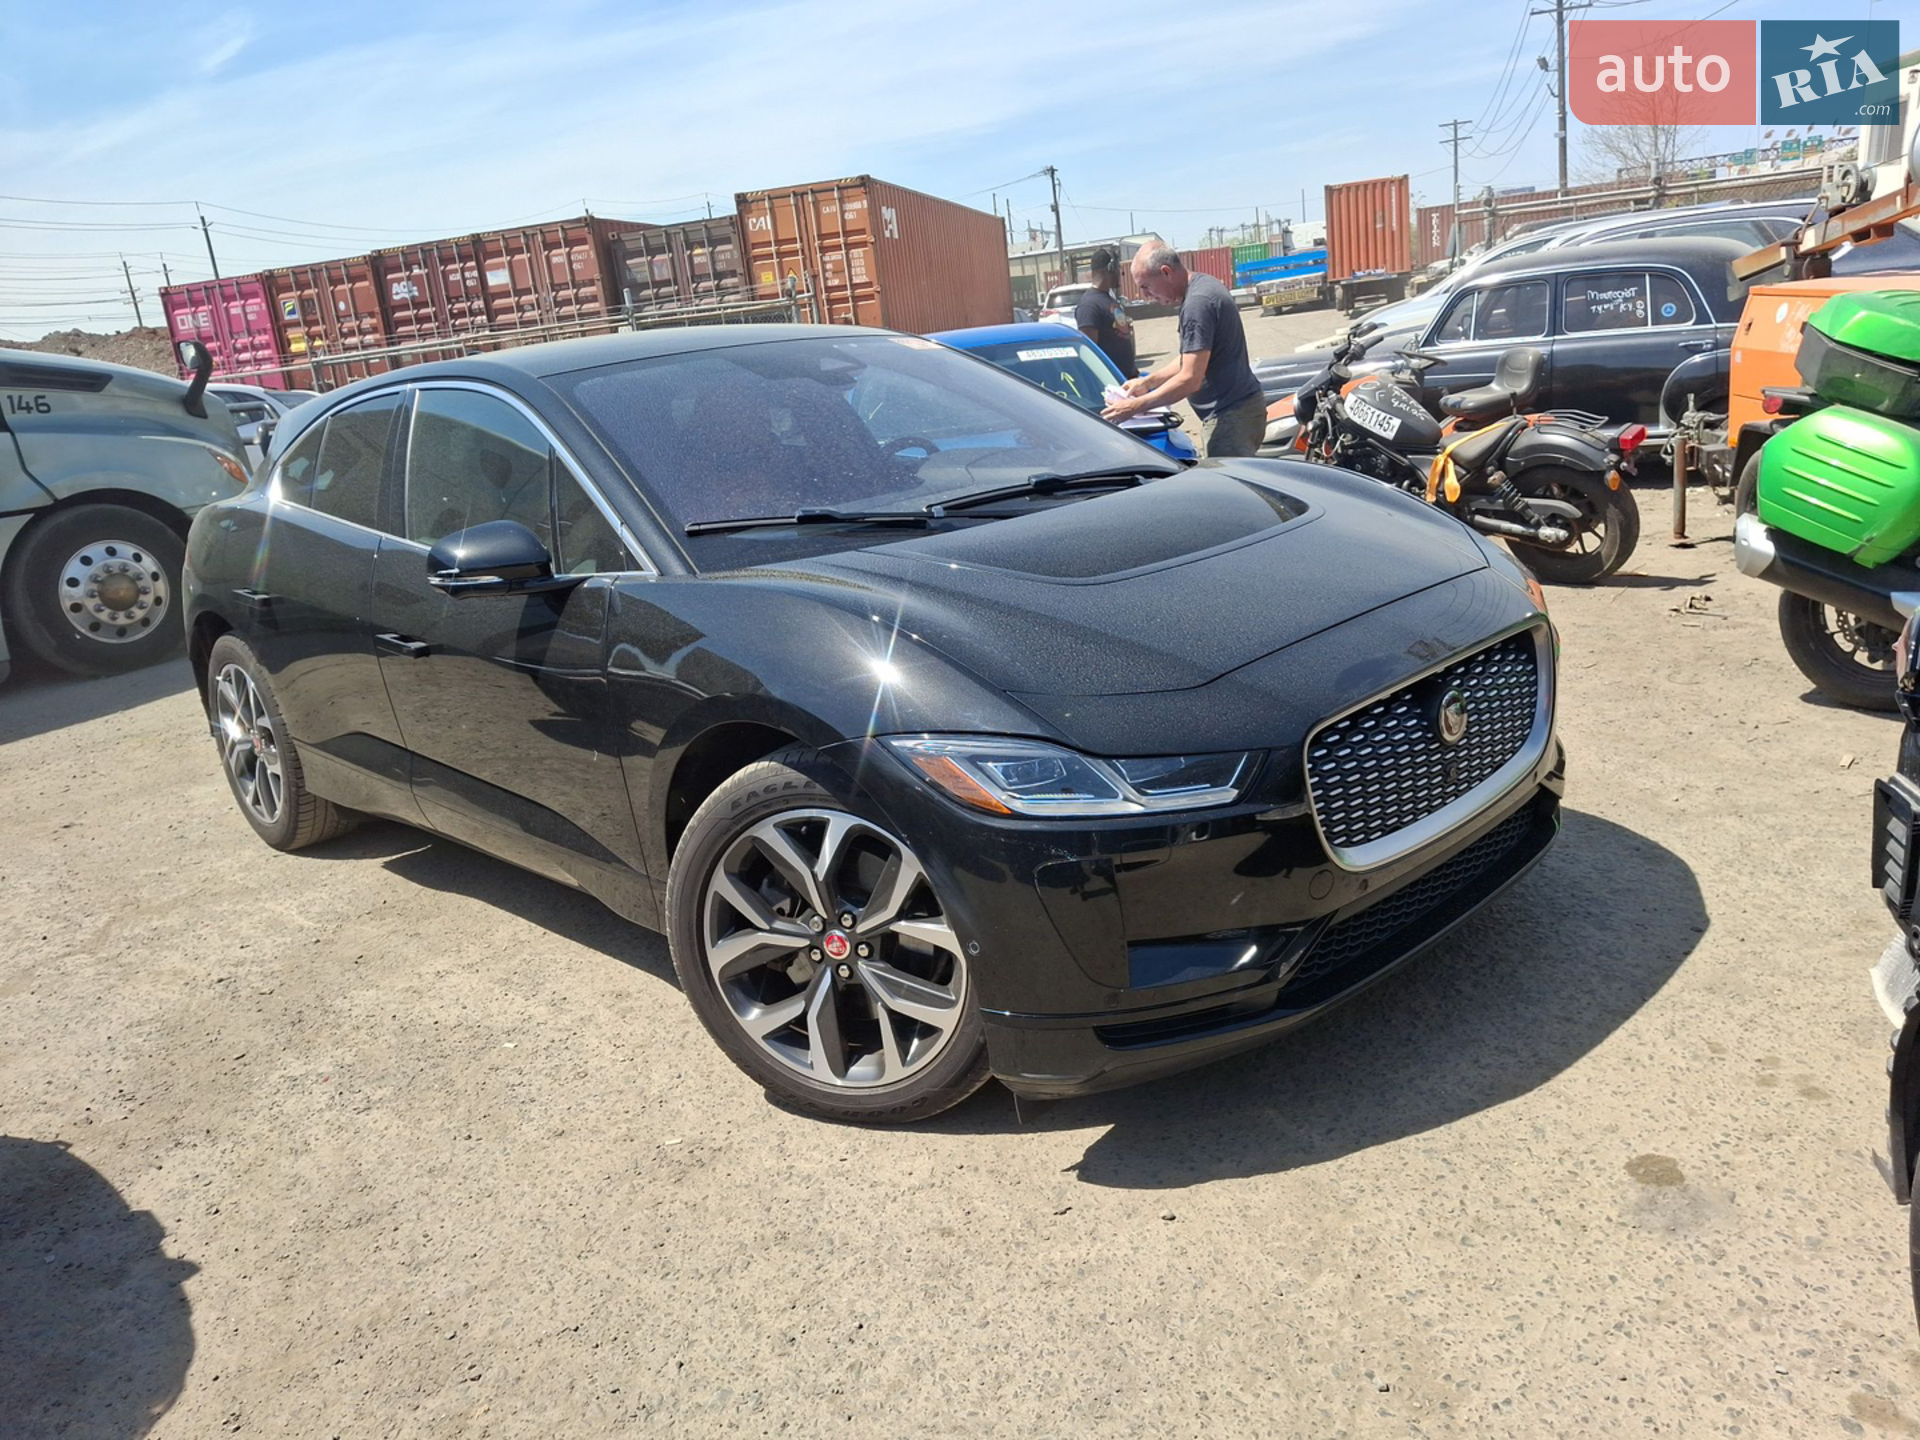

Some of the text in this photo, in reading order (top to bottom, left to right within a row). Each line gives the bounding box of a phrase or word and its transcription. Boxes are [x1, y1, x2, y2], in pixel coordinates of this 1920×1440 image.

[176, 312, 210, 330] ONE
[6, 394, 51, 414] 146
[730, 780, 818, 812] EAGLE
